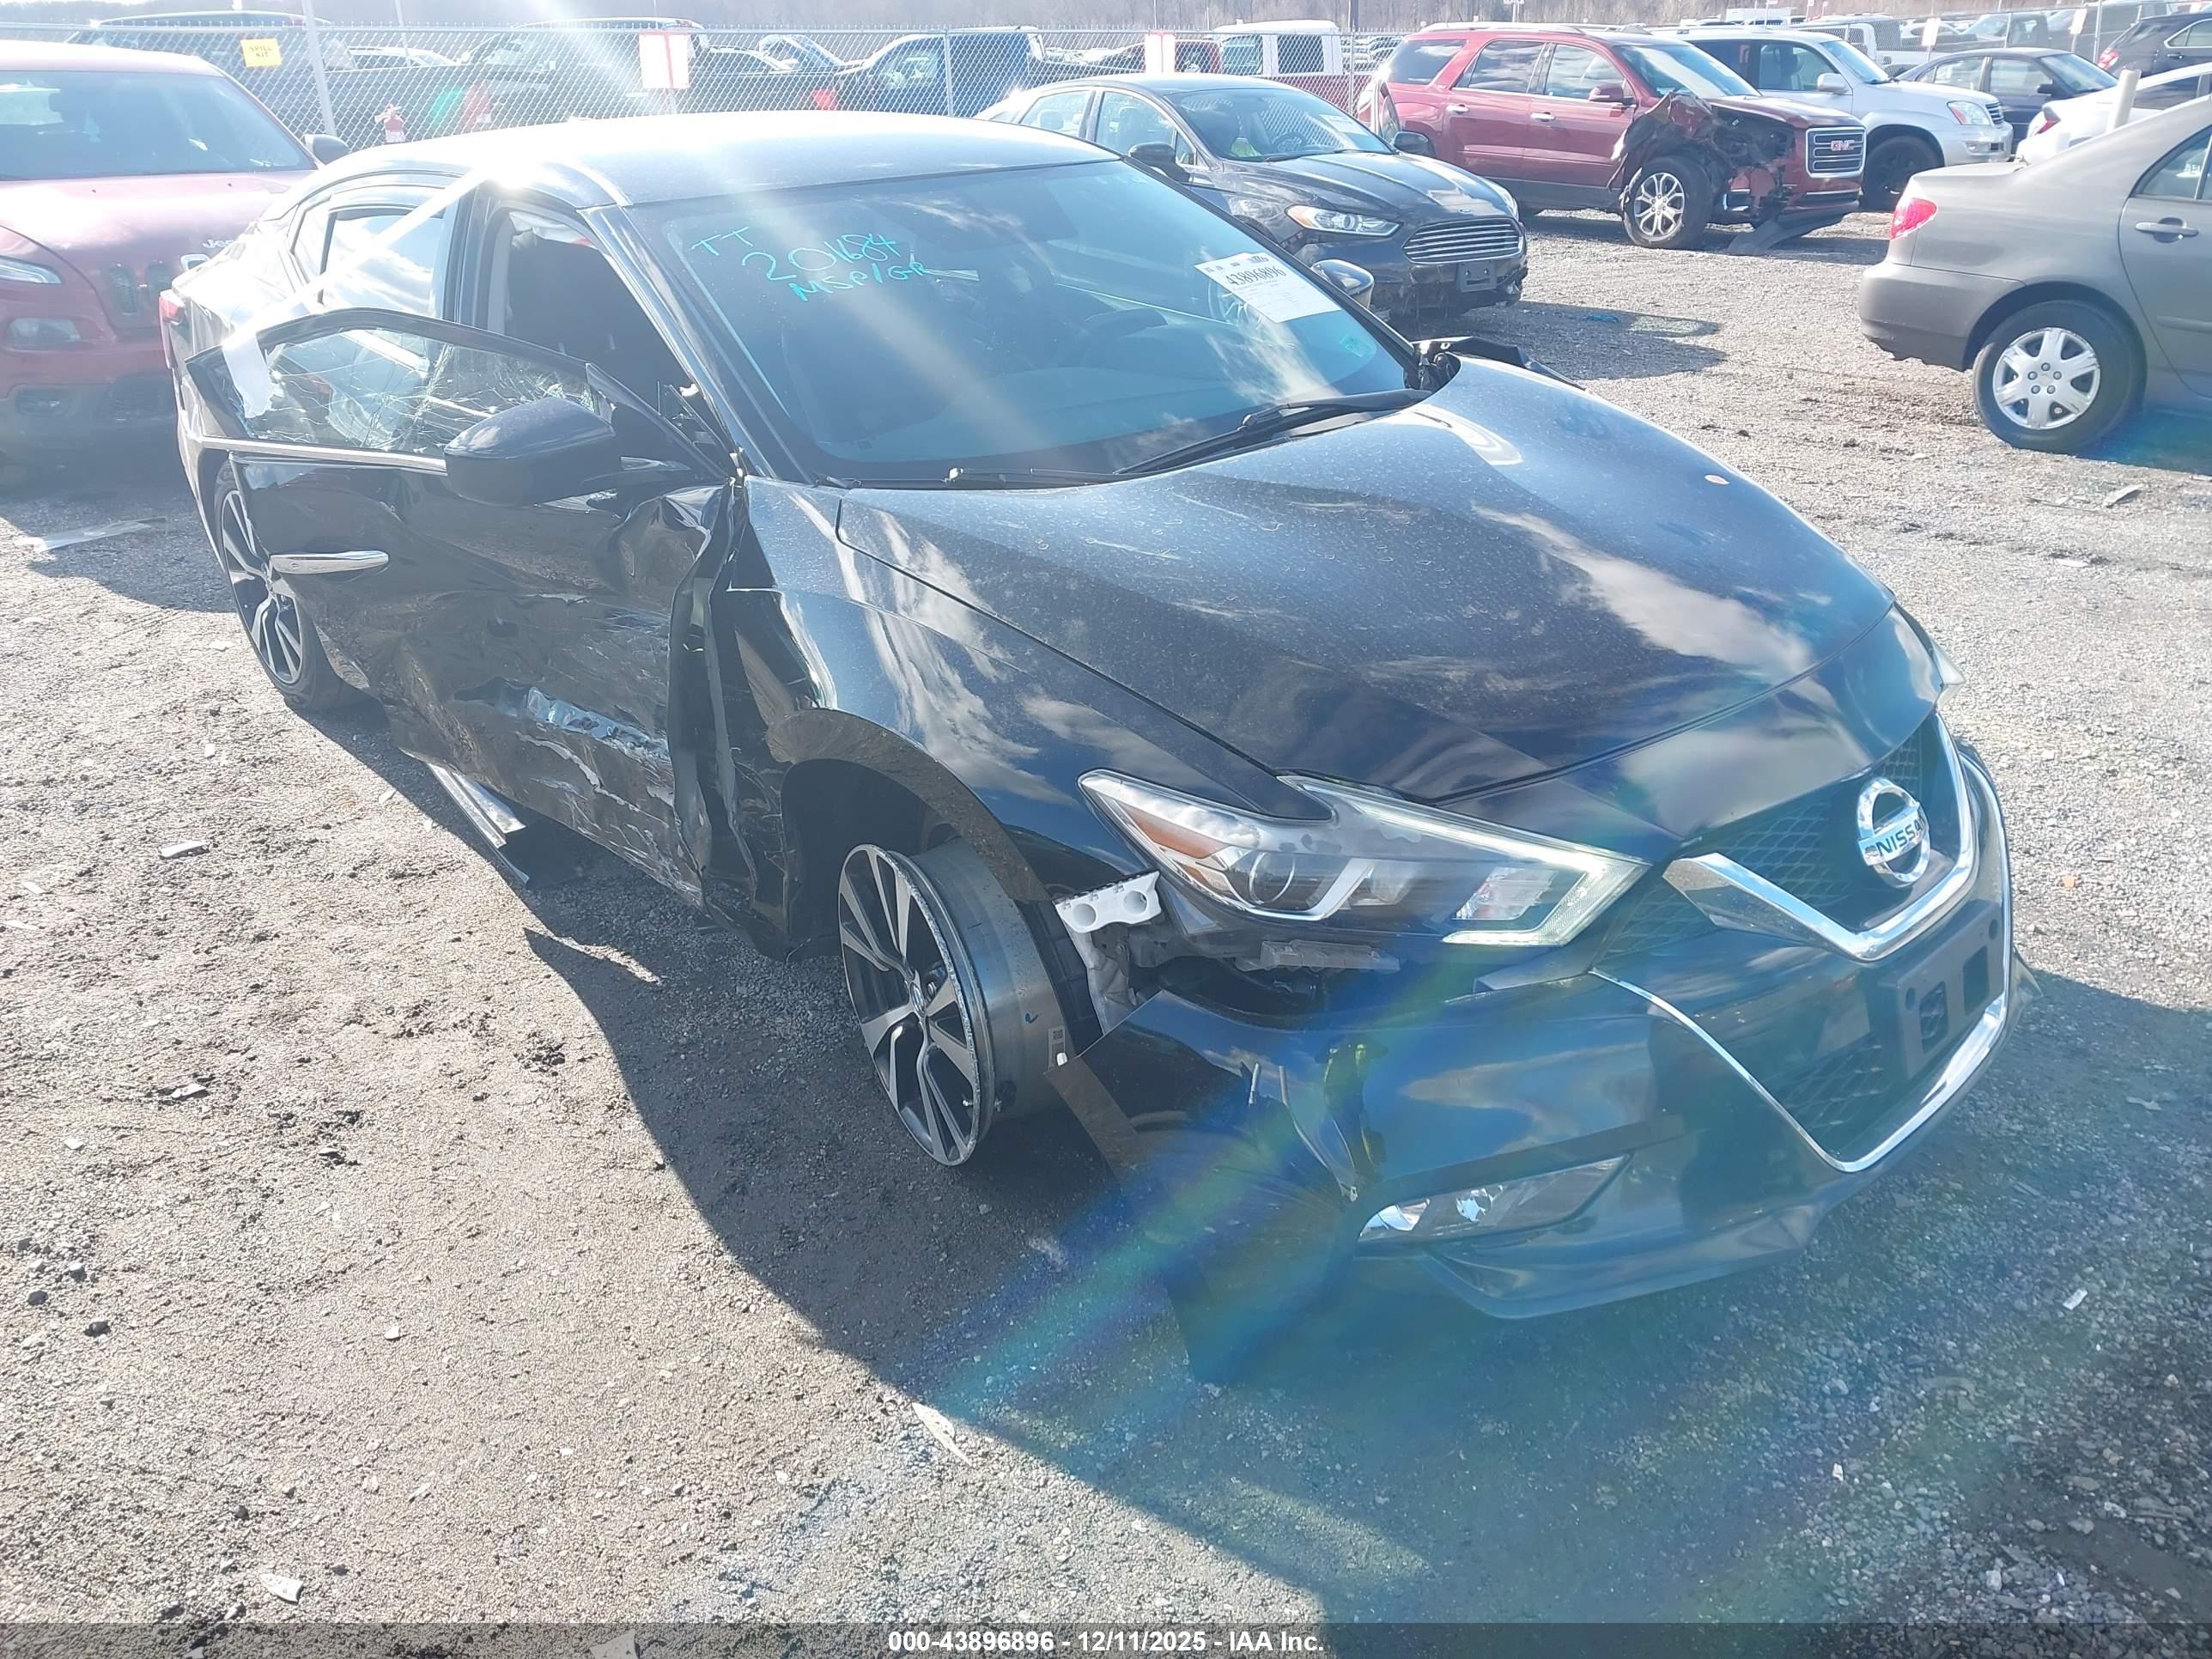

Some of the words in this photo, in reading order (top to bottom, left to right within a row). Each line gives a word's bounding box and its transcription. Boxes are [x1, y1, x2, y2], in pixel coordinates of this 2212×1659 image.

[1831, 139, 1855, 151] GMC
[691, 227, 753, 256] TT
[1224, 265, 1287, 286] 43896896
